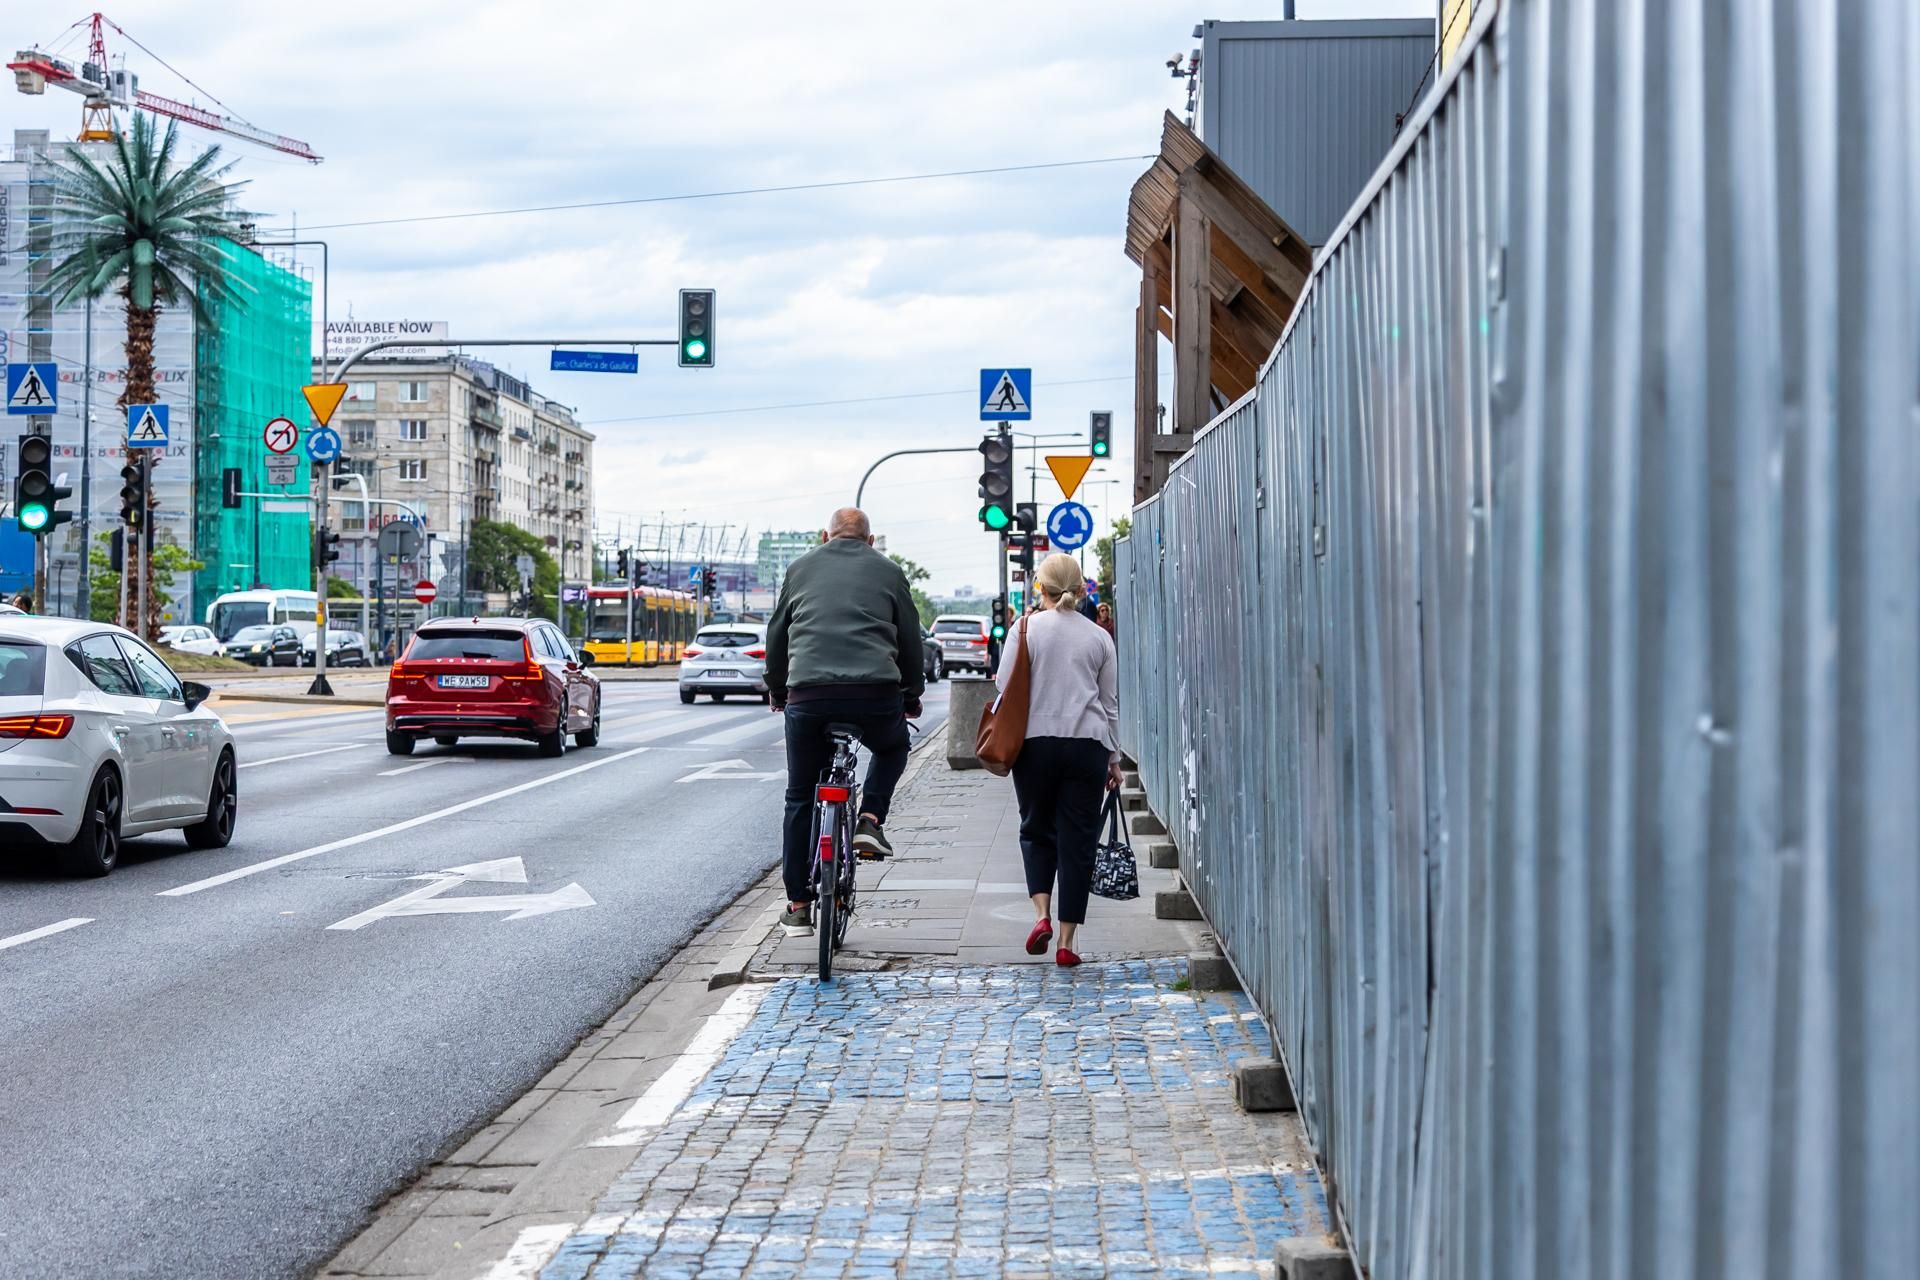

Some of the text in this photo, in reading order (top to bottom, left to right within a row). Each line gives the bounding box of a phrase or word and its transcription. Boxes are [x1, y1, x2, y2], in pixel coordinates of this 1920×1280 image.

[327, 322, 433, 333] AVAILABLE NOW
[444, 676, 487, 687] WE 9AW58
